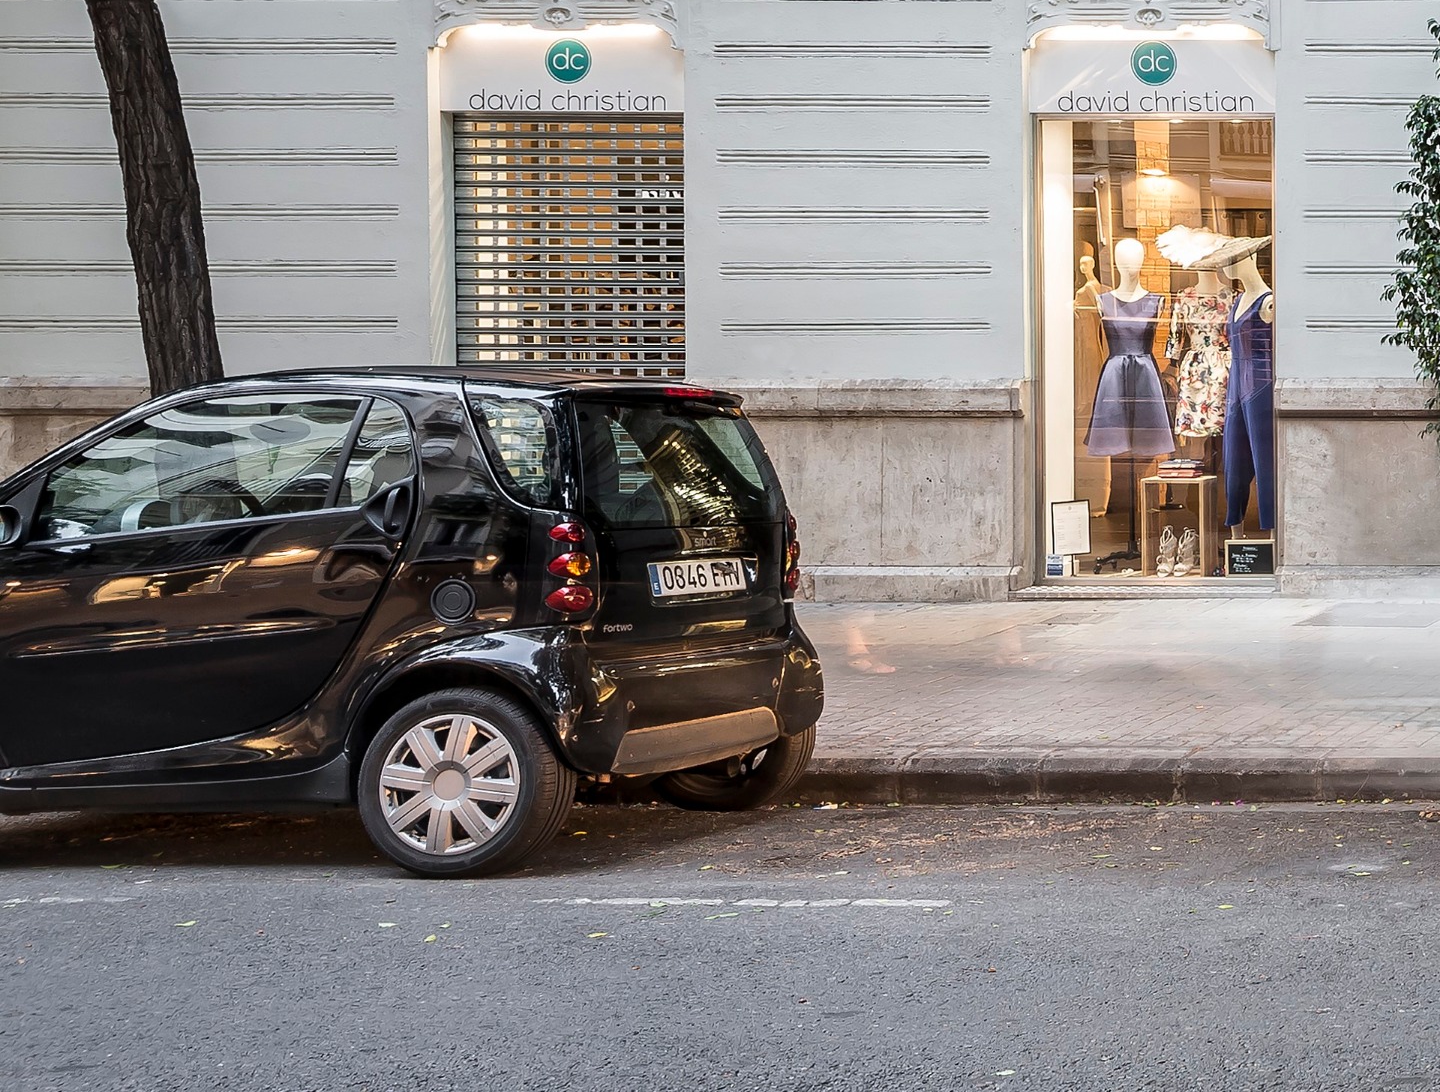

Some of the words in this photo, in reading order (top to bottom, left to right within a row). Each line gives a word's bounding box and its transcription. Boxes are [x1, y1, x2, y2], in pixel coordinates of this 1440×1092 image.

[553, 47, 584, 70] dc
[1137, 50, 1170, 72] dc
[469, 88, 541, 111] david
[551, 88, 666, 111] christian
[1057, 90, 1129, 112] david
[1139, 90, 1254, 112] christian
[694, 536, 717, 547] smart
[662, 563, 708, 590] 0846
[602, 623, 633, 633] fortwo
